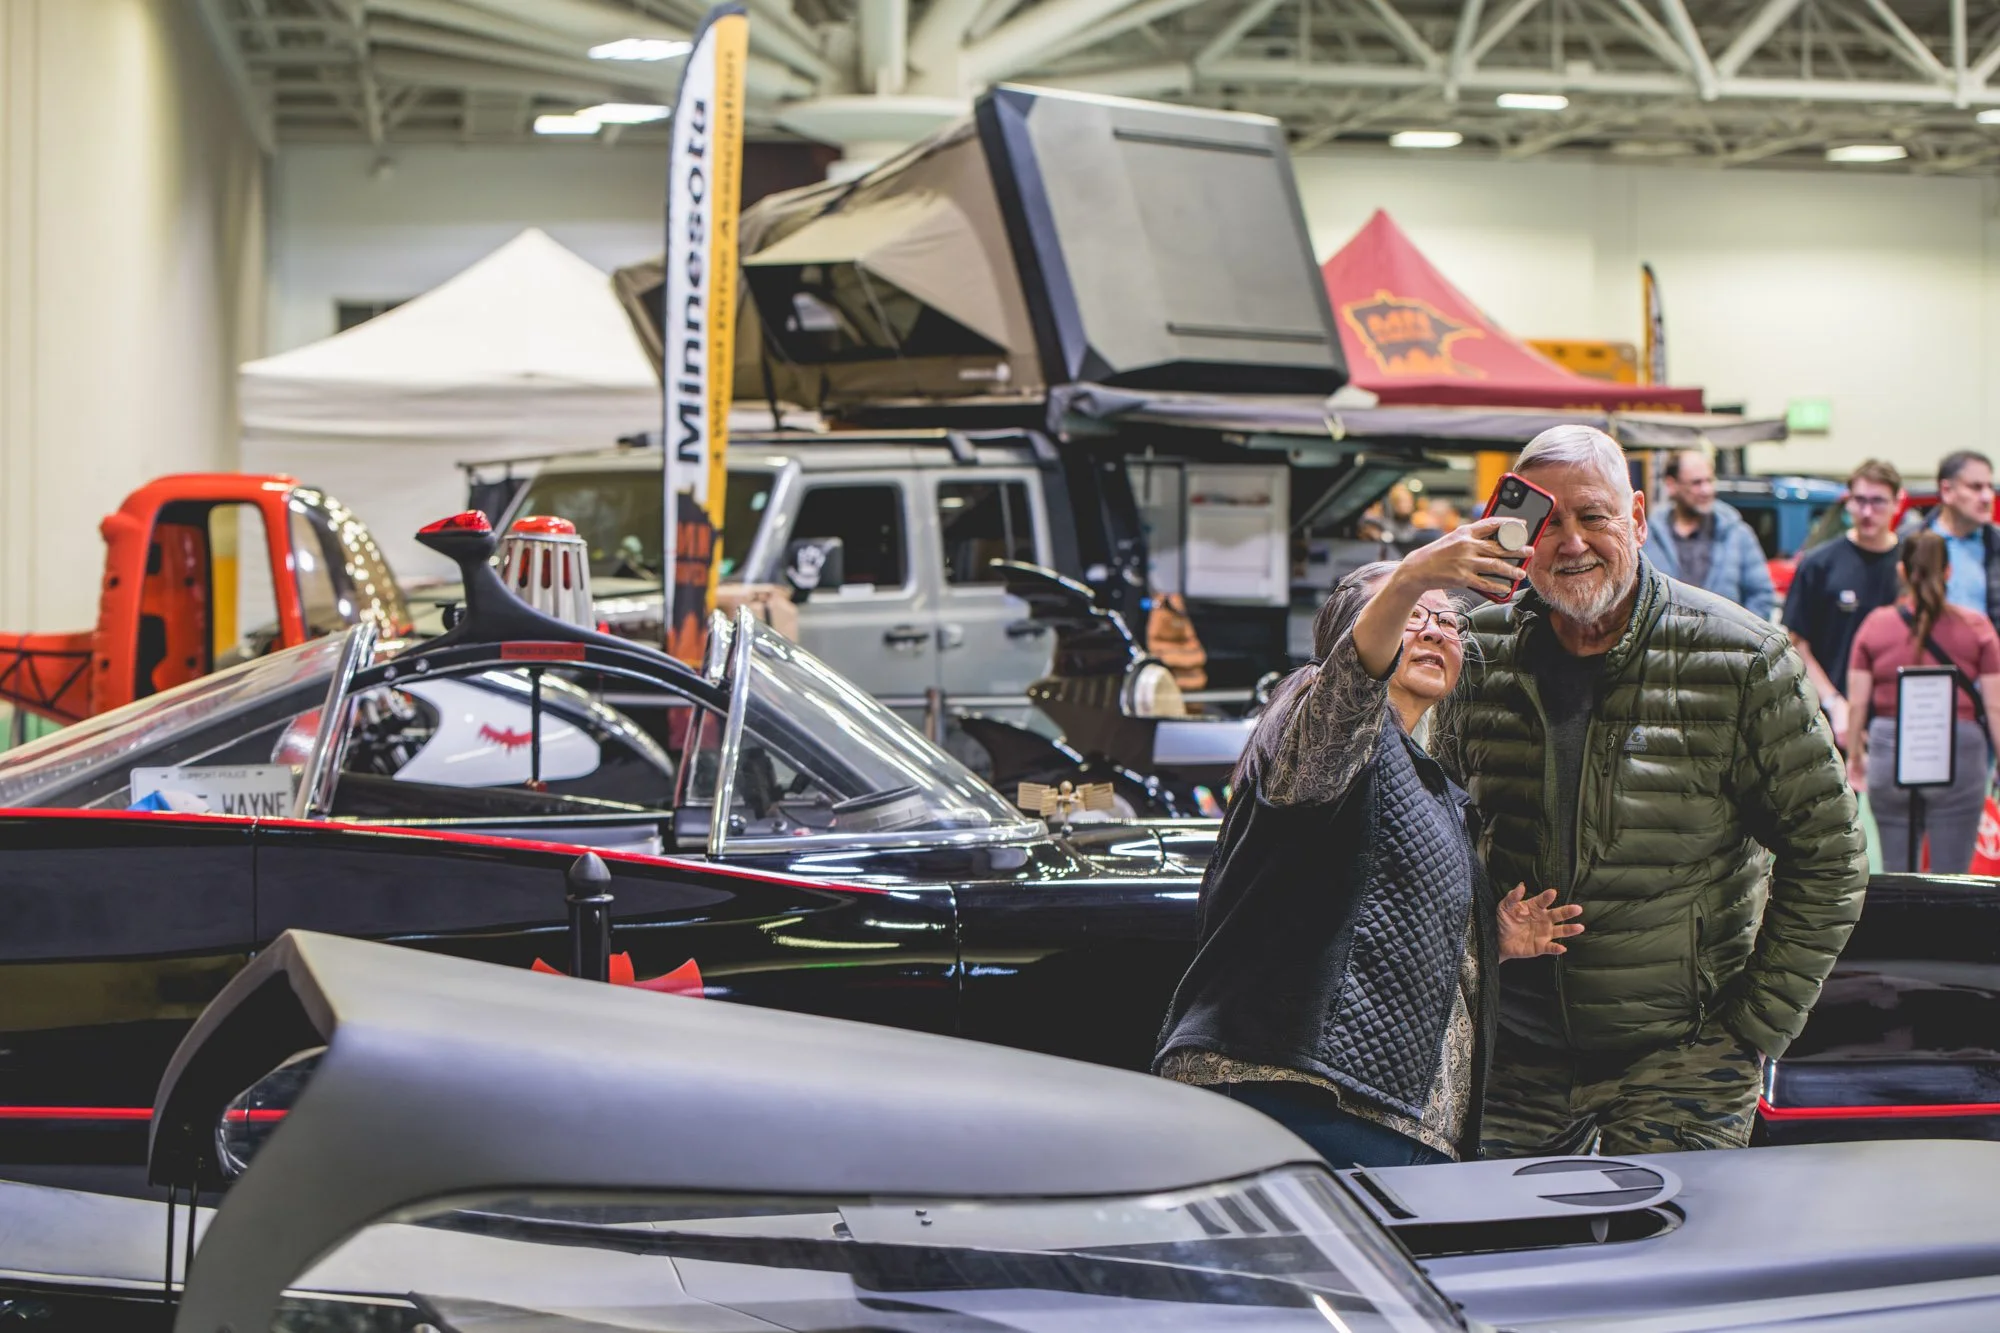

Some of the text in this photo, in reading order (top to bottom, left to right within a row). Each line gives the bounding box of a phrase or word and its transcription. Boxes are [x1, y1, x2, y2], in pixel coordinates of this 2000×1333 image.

[677, 100, 707, 464] Minnesota
[178, 770, 248, 780] SUPPORT POLICE
[222, 793, 288, 817] WAYNE
